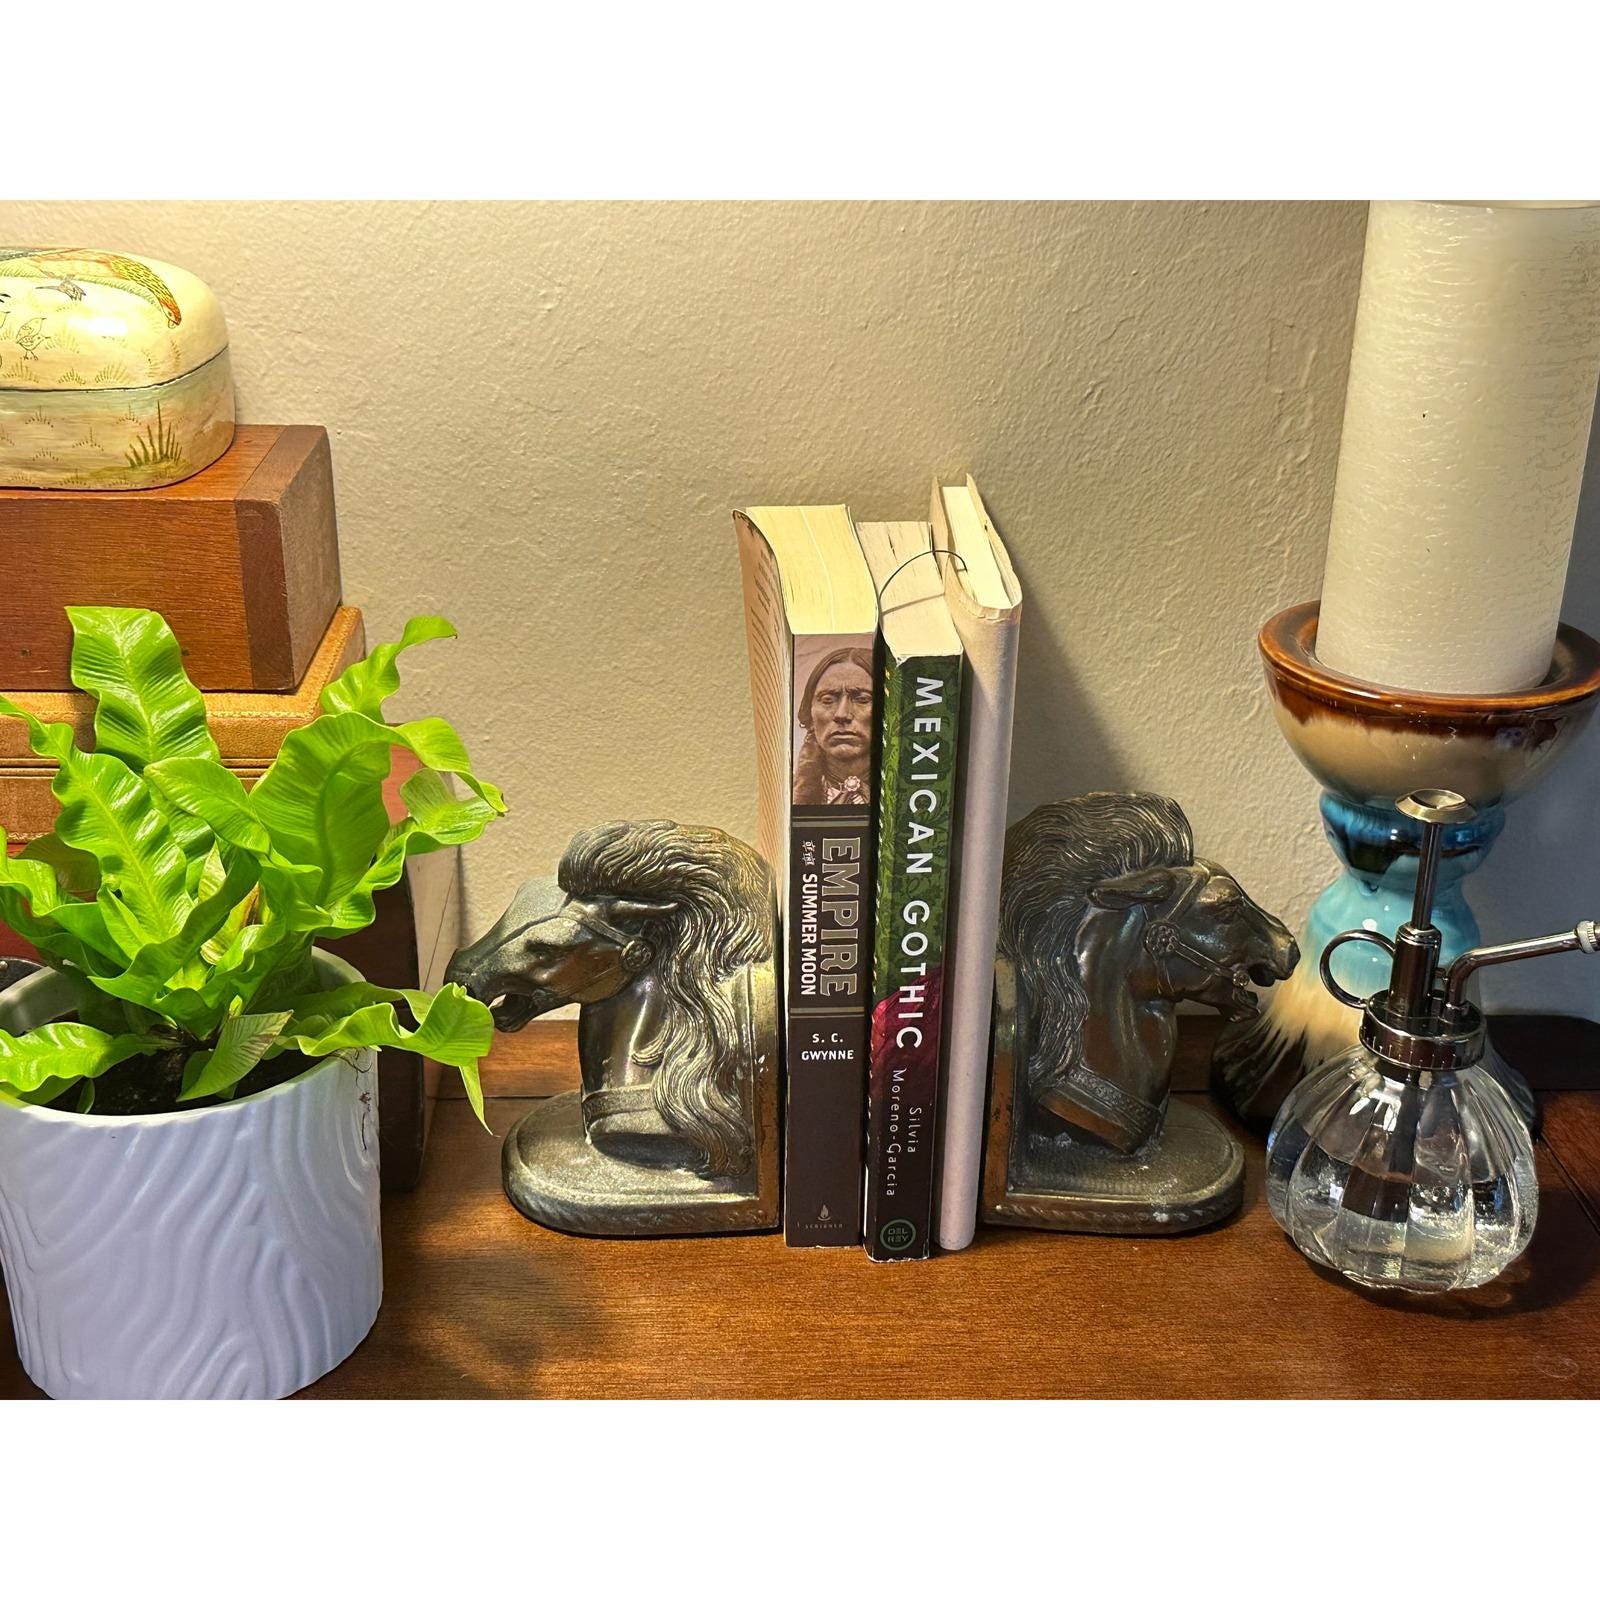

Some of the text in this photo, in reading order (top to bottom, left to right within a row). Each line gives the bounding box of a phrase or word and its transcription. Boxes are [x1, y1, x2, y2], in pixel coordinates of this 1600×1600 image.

[820, 837, 861, 997] EMPIRE
[896, 677, 944, 1049] MEXICAN GOTHIC
[800, 873, 818, 995] SUMMER MOON
[801, 1050, 854, 1060] GWYNNE
[812, 1033, 844, 1043] S. C.
[886, 1067, 907, 1196] Moreno-Garcia
[907, 1107, 922, 1153] Silvia
